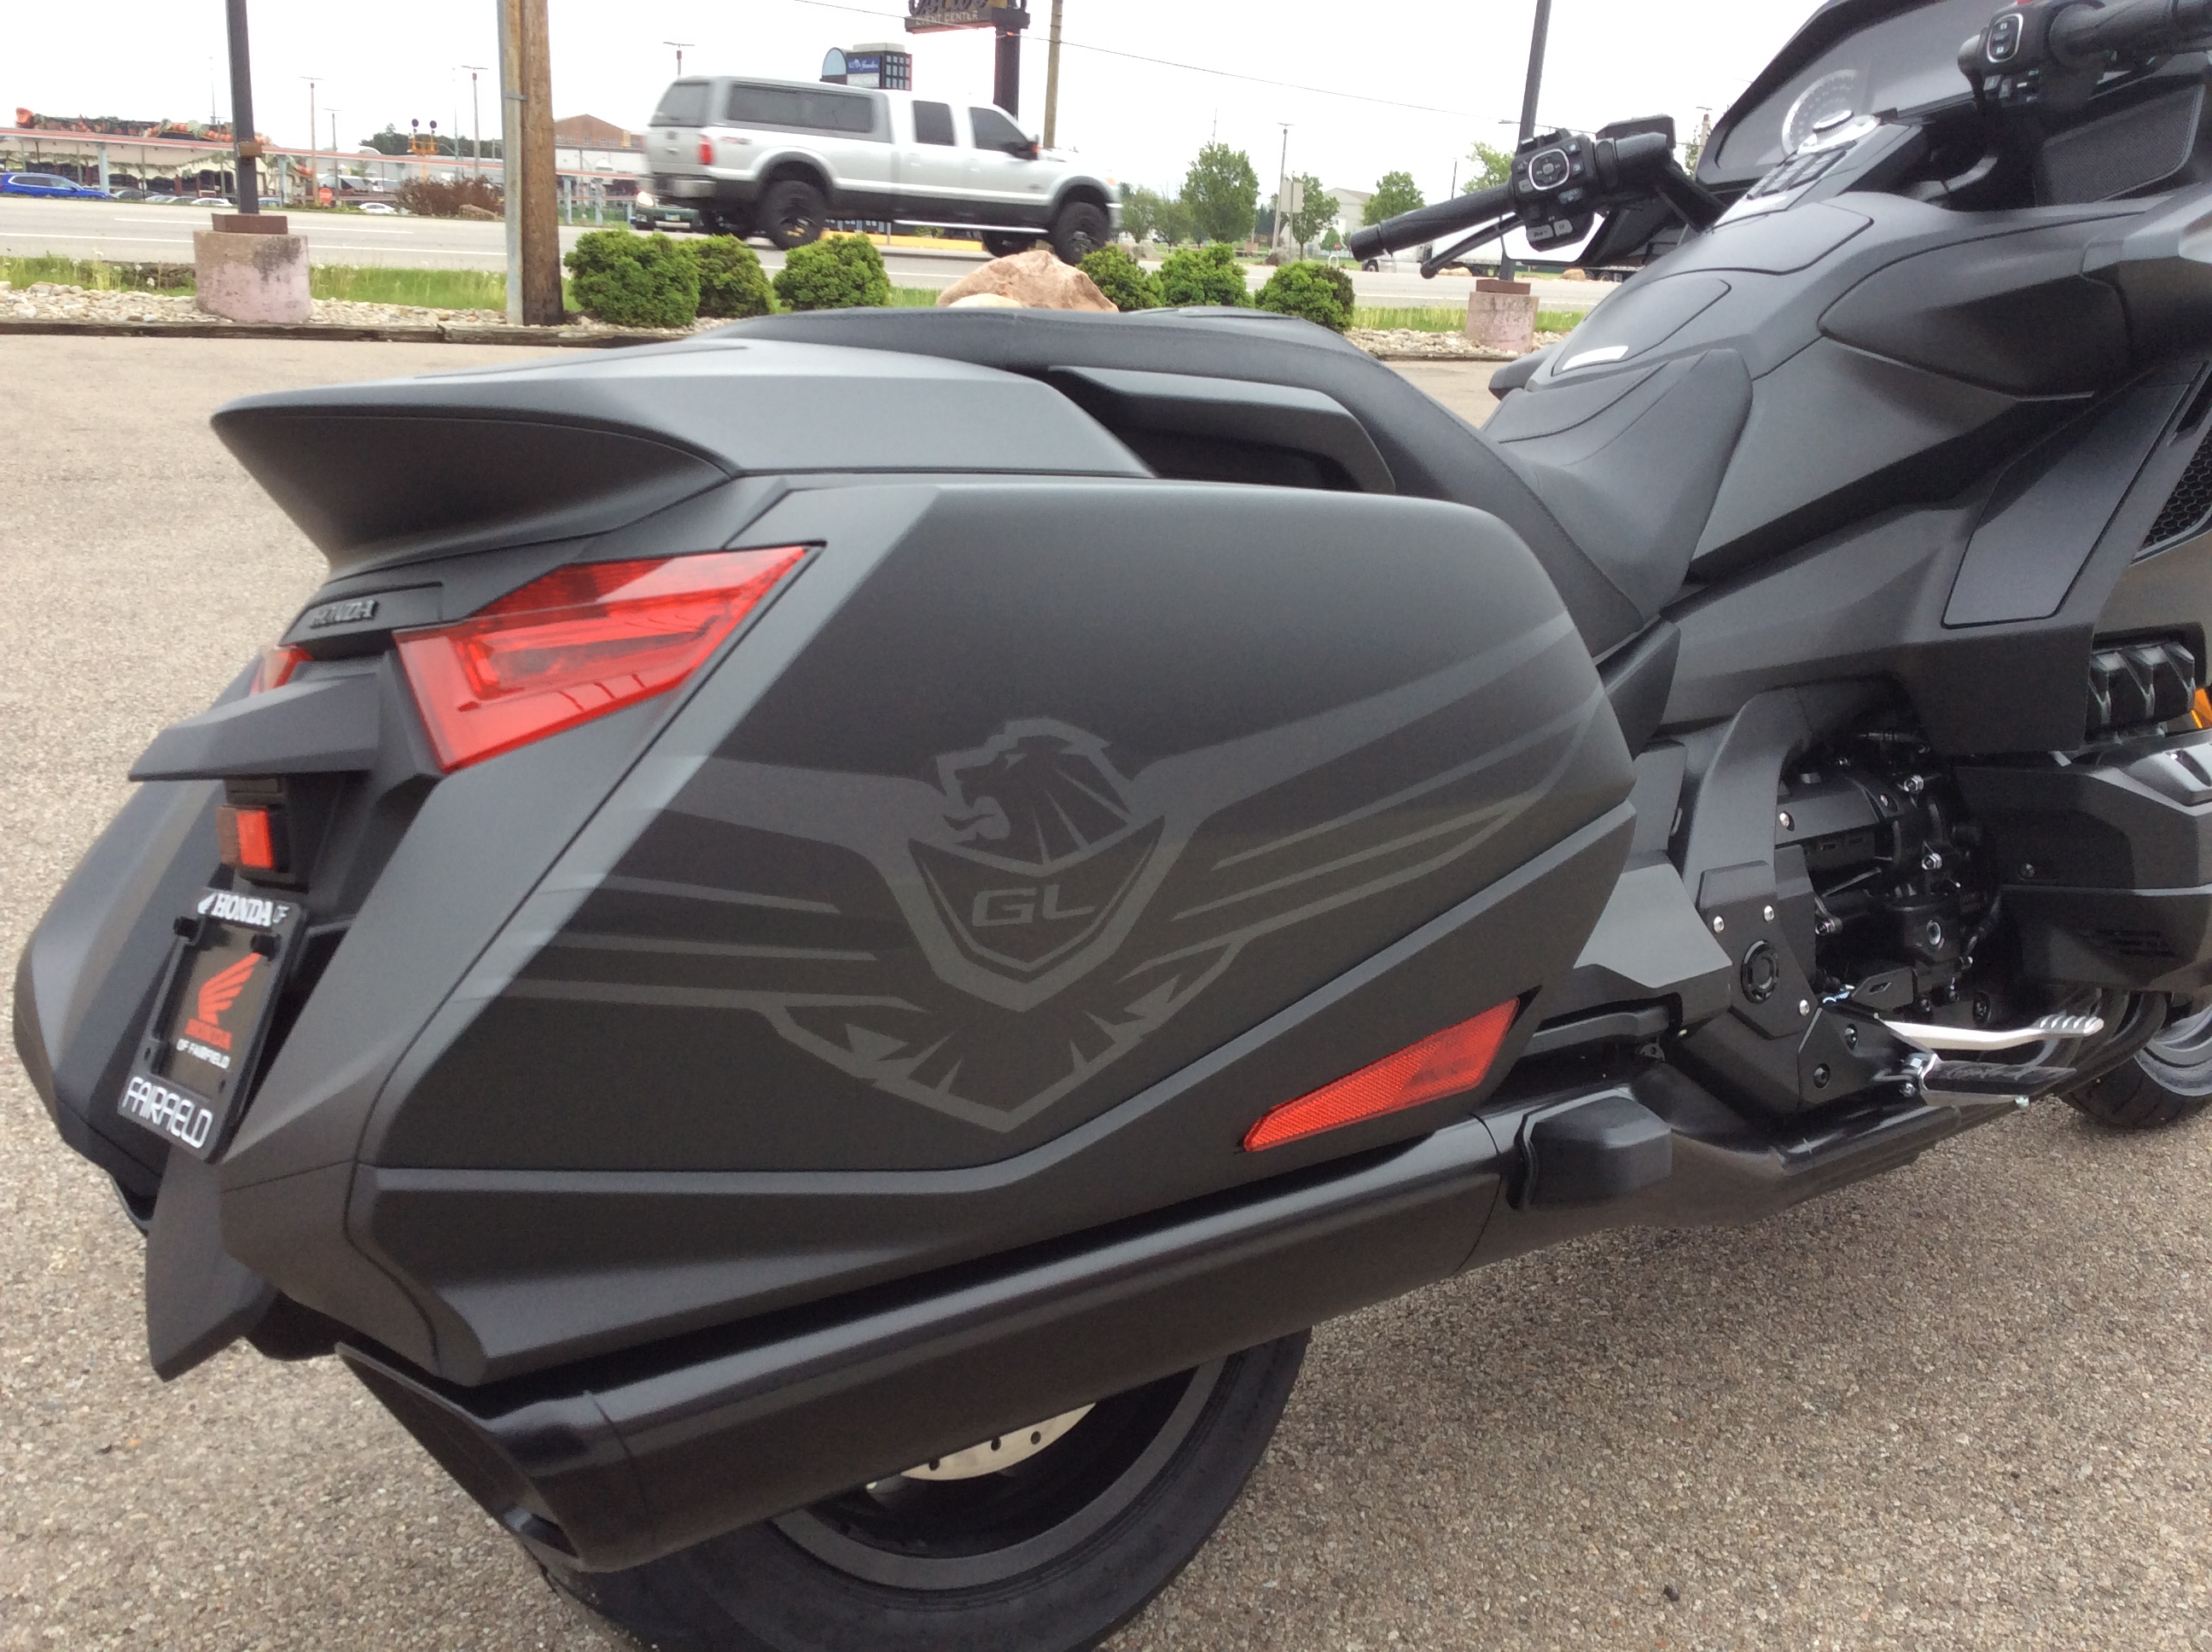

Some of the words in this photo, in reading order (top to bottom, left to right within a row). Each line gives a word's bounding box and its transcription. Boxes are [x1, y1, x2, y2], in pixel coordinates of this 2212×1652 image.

[944, 10, 978, 22] CENTER
[210, 893, 272, 927] HONDA
[972, 884, 1094, 927] GL
[177, 1038, 189, 1051] OF
[187, 1042, 232, 1069] FAIRFIELD
[121, 1077, 213, 1149] FAIRFIELD
